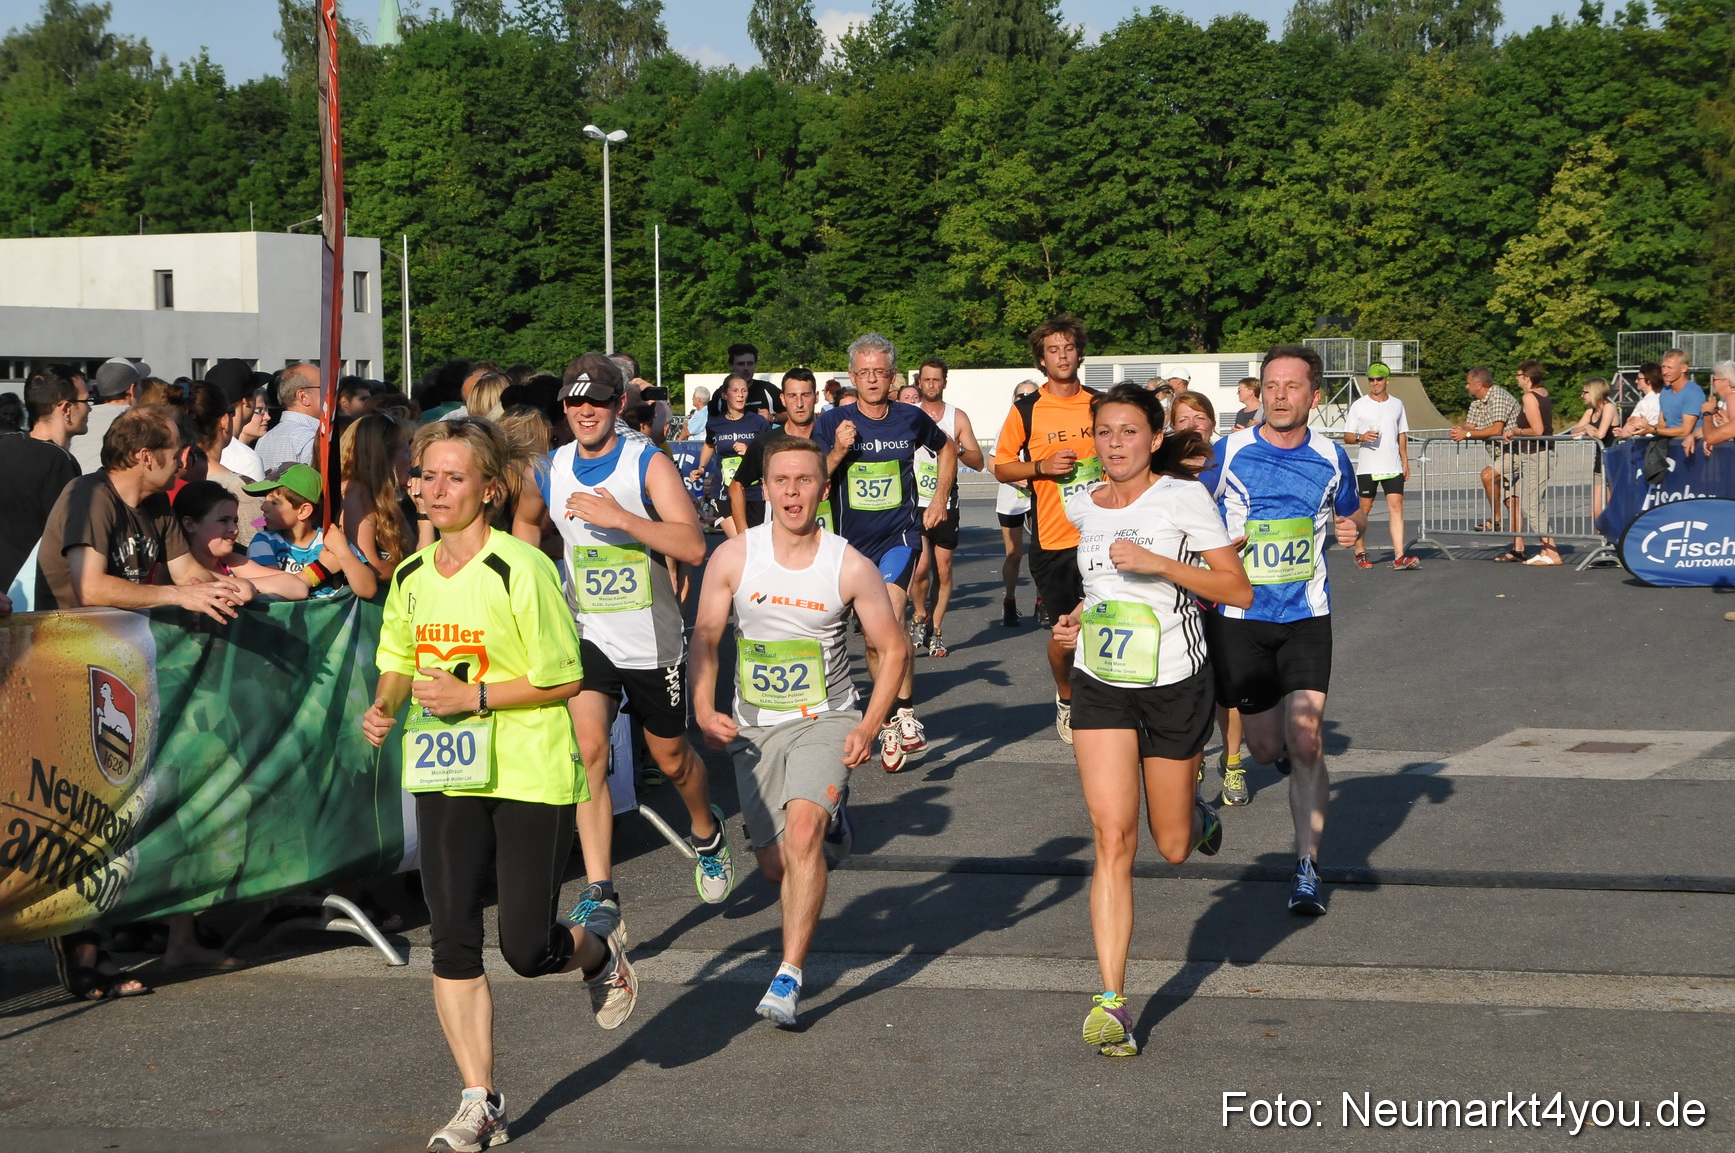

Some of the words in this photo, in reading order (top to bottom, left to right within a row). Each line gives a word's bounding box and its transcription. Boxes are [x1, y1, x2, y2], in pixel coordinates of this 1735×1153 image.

[882, 440, 909, 450] POLES
[856, 478, 892, 498] 357
[1114, 528, 1140, 537] HECK
[1250, 540, 1311, 568] 1042
[1664, 536, 1735, 558] Fisch
[586, 567, 638, 596] 523
[771, 596, 829, 612] KLEBL
[416, 623, 485, 644] Müller
[1098, 627, 1134, 660] 27
[752, 663, 811, 693] 532
[415, 730, 476, 769] 280
[102, 750, 124, 776] 1628
